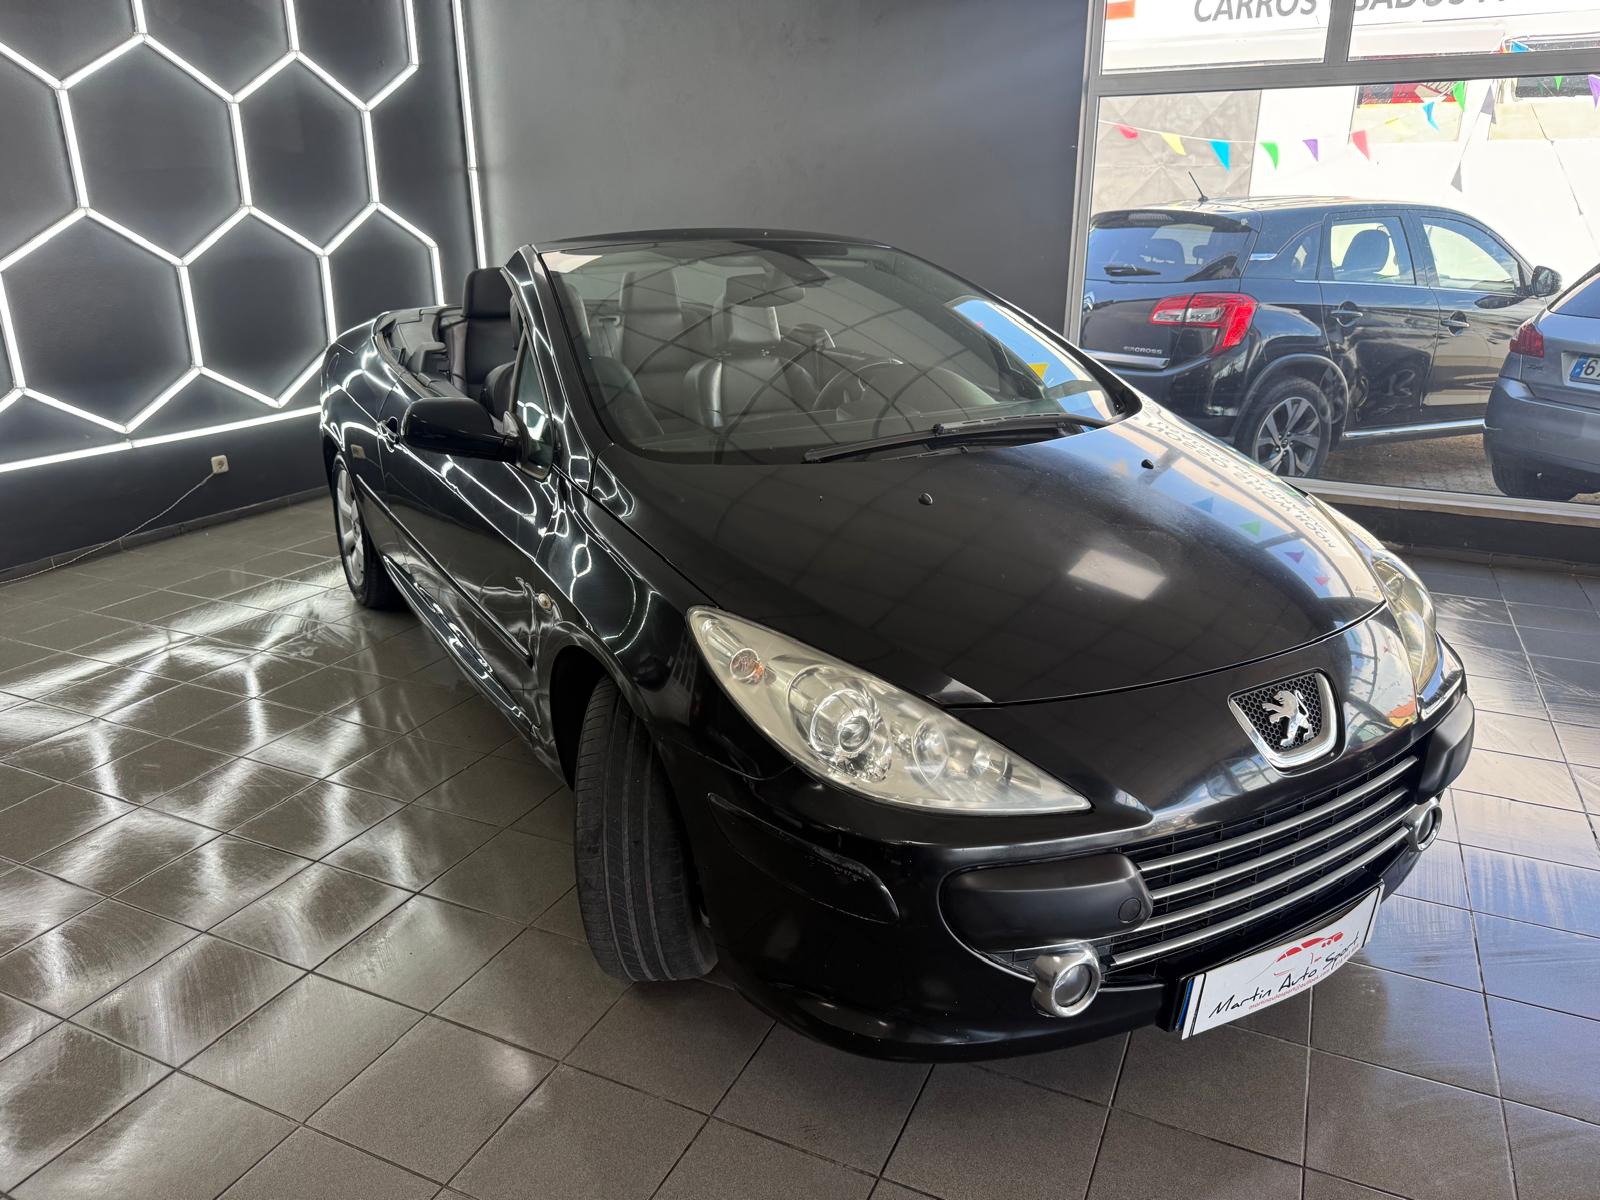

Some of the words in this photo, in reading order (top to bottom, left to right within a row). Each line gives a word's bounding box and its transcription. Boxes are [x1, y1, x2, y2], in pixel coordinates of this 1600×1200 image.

[1209, 986, 1272, 1018] Martin
[1278, 966, 1317, 992] Auto
[1323, 930, 1359, 970] Sport
